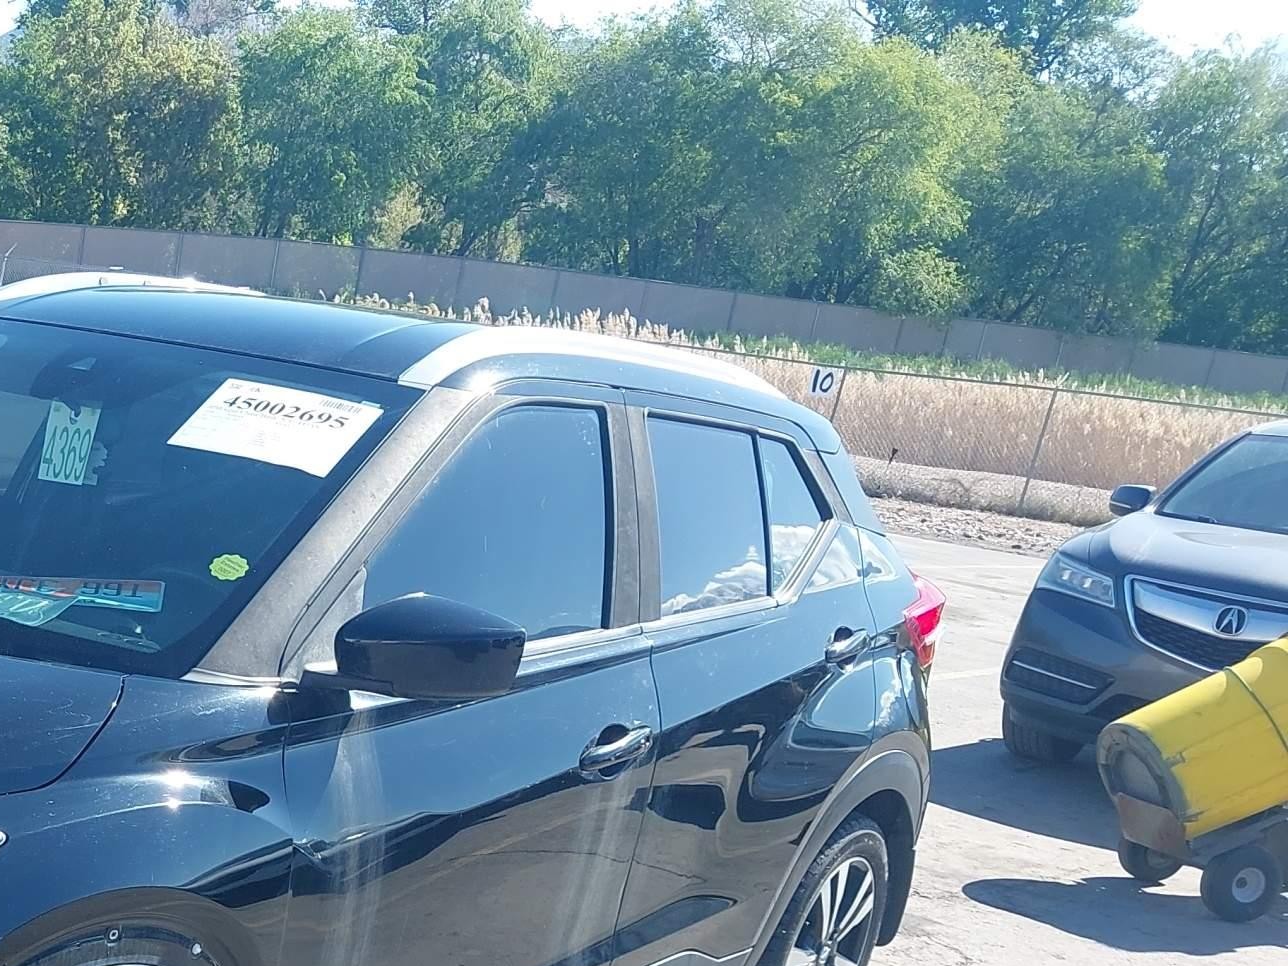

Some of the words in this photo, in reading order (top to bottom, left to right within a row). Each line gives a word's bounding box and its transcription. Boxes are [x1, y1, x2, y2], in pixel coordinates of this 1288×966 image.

[812, 369, 834, 393] 10
[223, 396, 350, 430] 45002695
[42, 425, 92, 481] 4369
